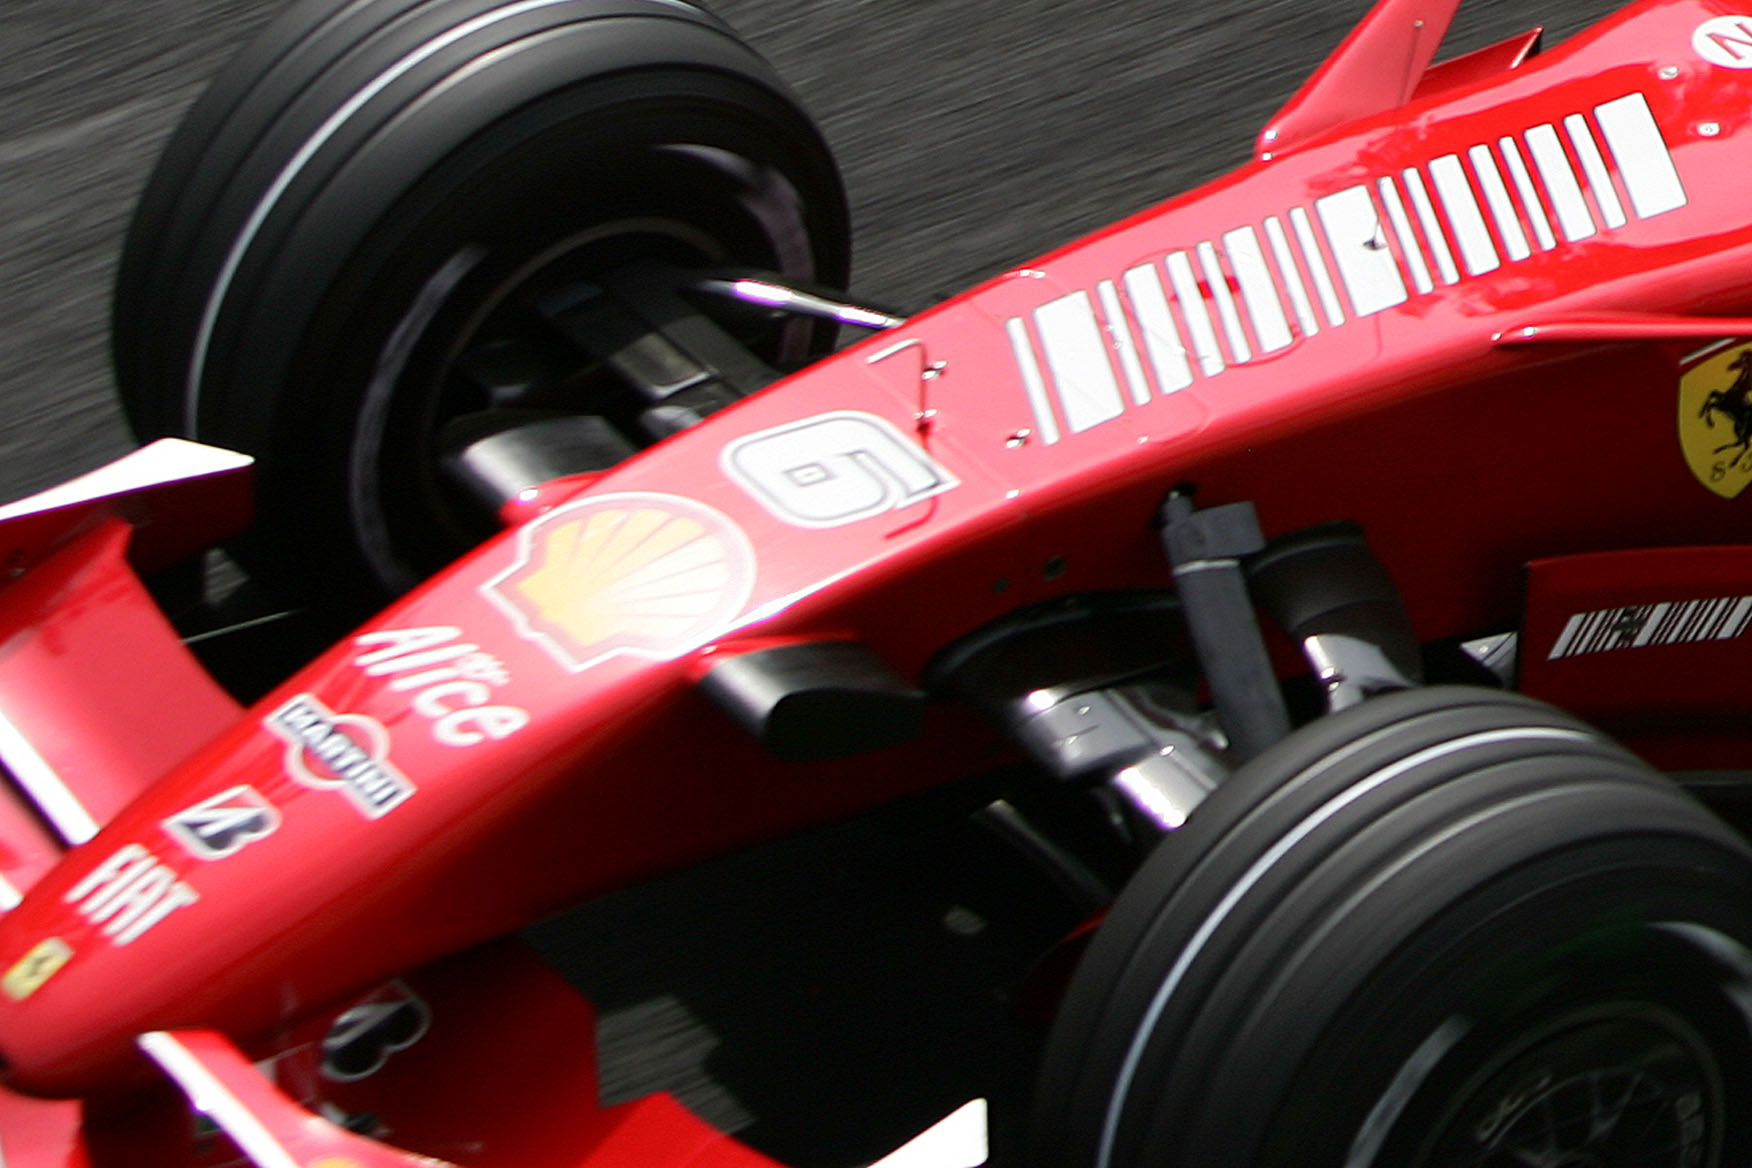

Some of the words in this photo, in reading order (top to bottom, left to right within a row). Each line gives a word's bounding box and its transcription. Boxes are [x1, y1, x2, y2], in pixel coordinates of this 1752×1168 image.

[719, 410, 961, 529] 6
[355, 625, 530, 748] Alice
[276, 700, 402, 808] MARTINI
[63, 843, 200, 948] FIAT
